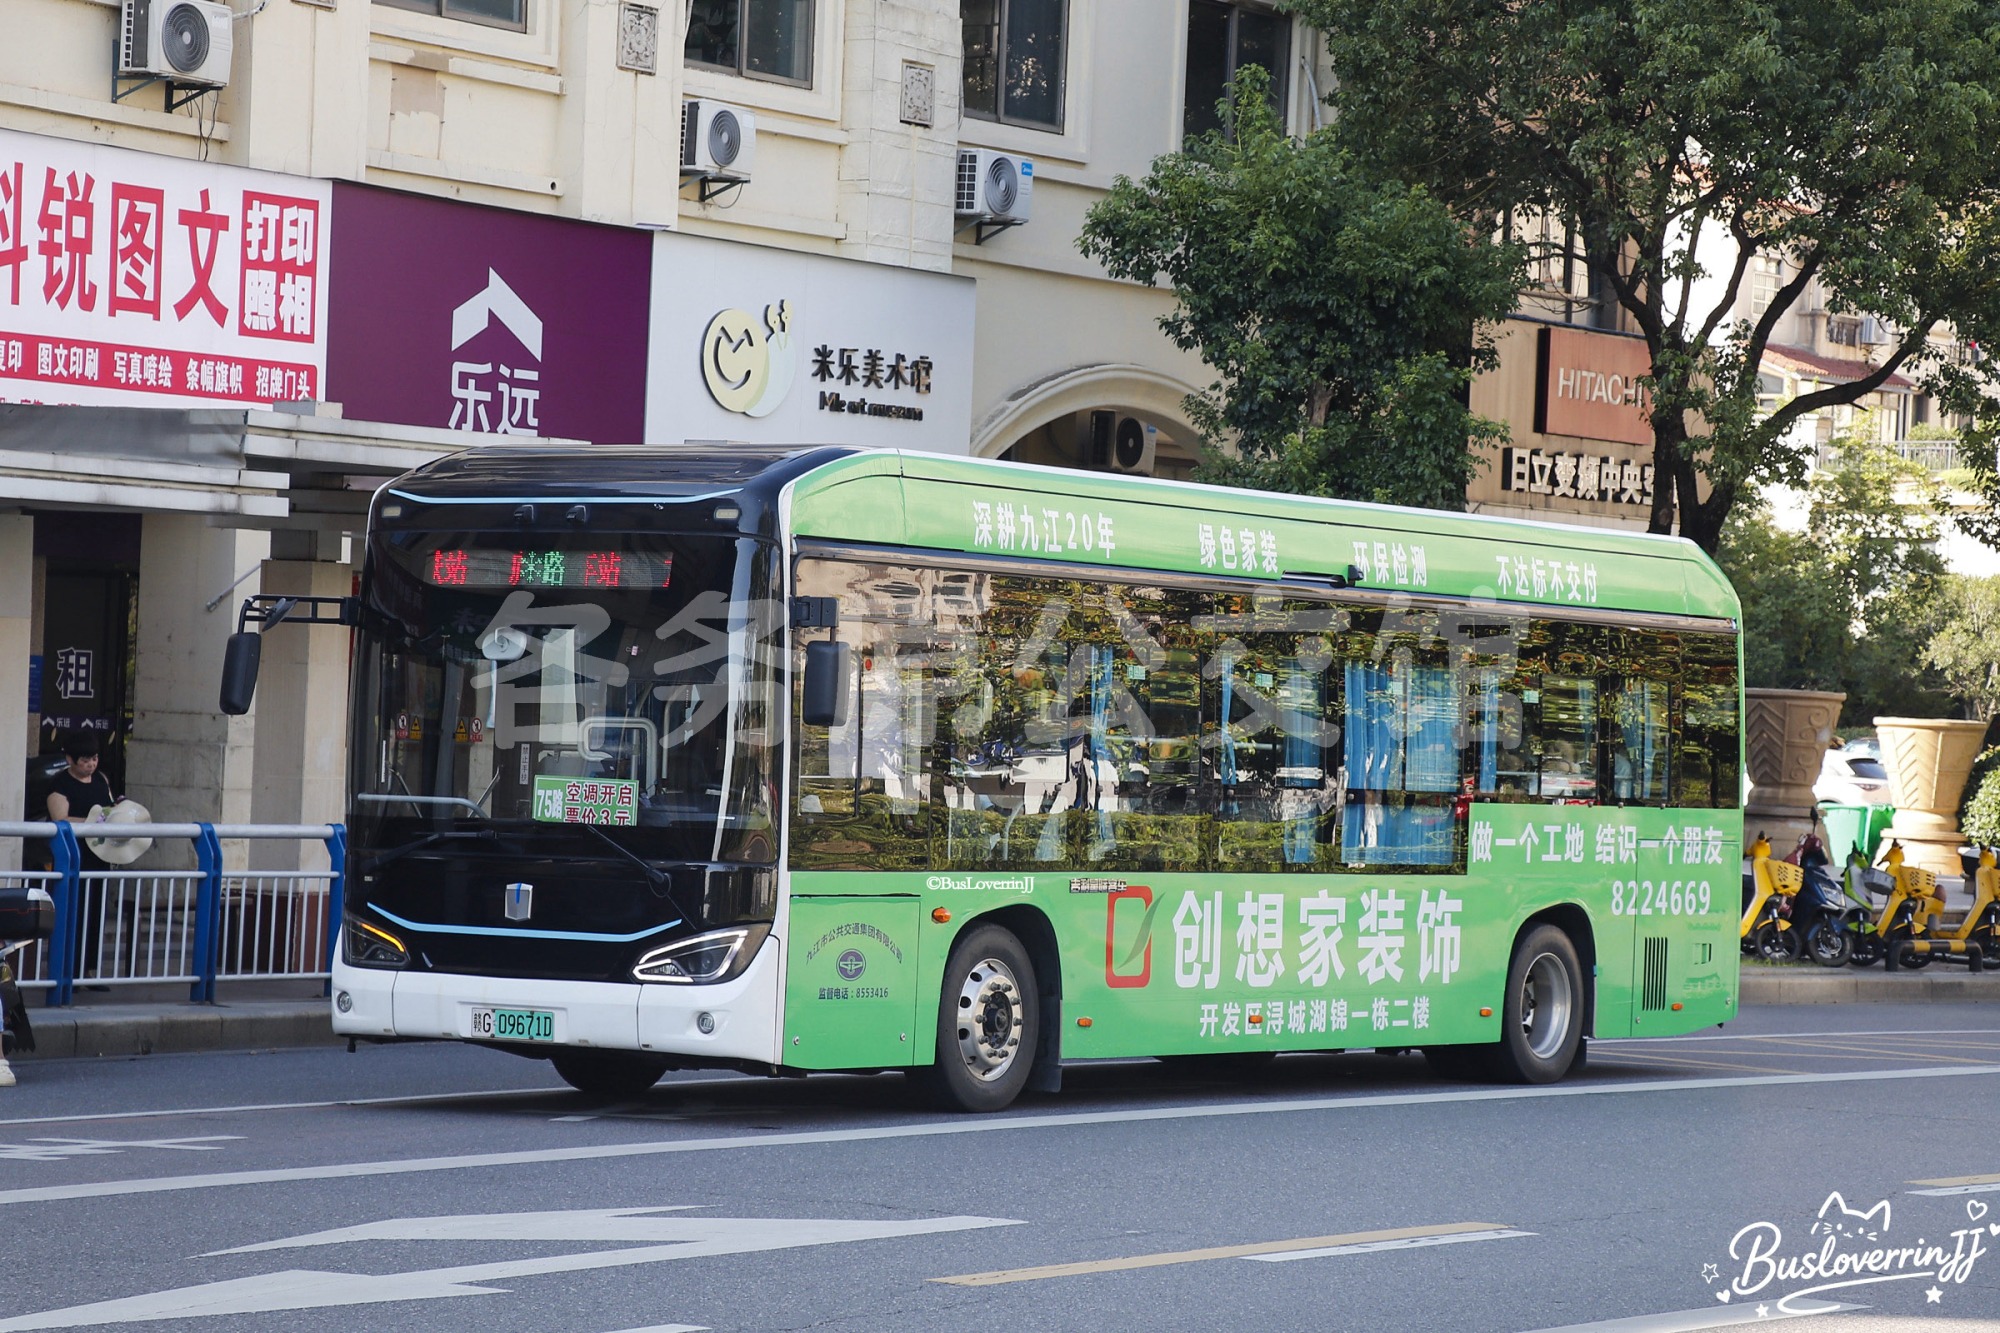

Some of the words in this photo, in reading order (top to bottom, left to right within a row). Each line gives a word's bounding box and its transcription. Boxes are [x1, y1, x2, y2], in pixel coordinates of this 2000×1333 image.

[246, 199, 315, 267] 打印
[243, 268, 312, 336] 照相
[37, 343, 99, 382] 图文印刷
[113, 351, 173, 389] 写真喷绘
[185, 358, 243, 395] 条幅旗帜
[255, 365, 311, 402] 招牌门头
[811, 344, 933, 394] 米乐美术馆
[1558, 367, 1644, 408] HITACHI
[448, 361, 540, 437] 乐远
[972, 499, 1116, 559] 深耕九江20年
[1198, 522, 1279, 574] 绿色家装
[1352, 540, 1428, 587] 环保检测
[1495, 555, 1598, 604] 不达标不交付
[56, 647, 94, 699] 租
[536, 788, 563, 820] 75路
[564, 806, 632, 825] 票价3元
[566, 782, 633, 807] 空调开启
[1471, 820, 1585, 863] 做一个工地
[1595, 823, 1723, 865] 结识一个朋友
[1611, 880, 1711, 916] 8224669
[805, 922, 903, 966] 九江市公共交通集团有限公司
[1172, 888, 1463, 990] 创想家装饰
[1199, 995, 1430, 1038] 开发区浔城湖锦一栋二楼
